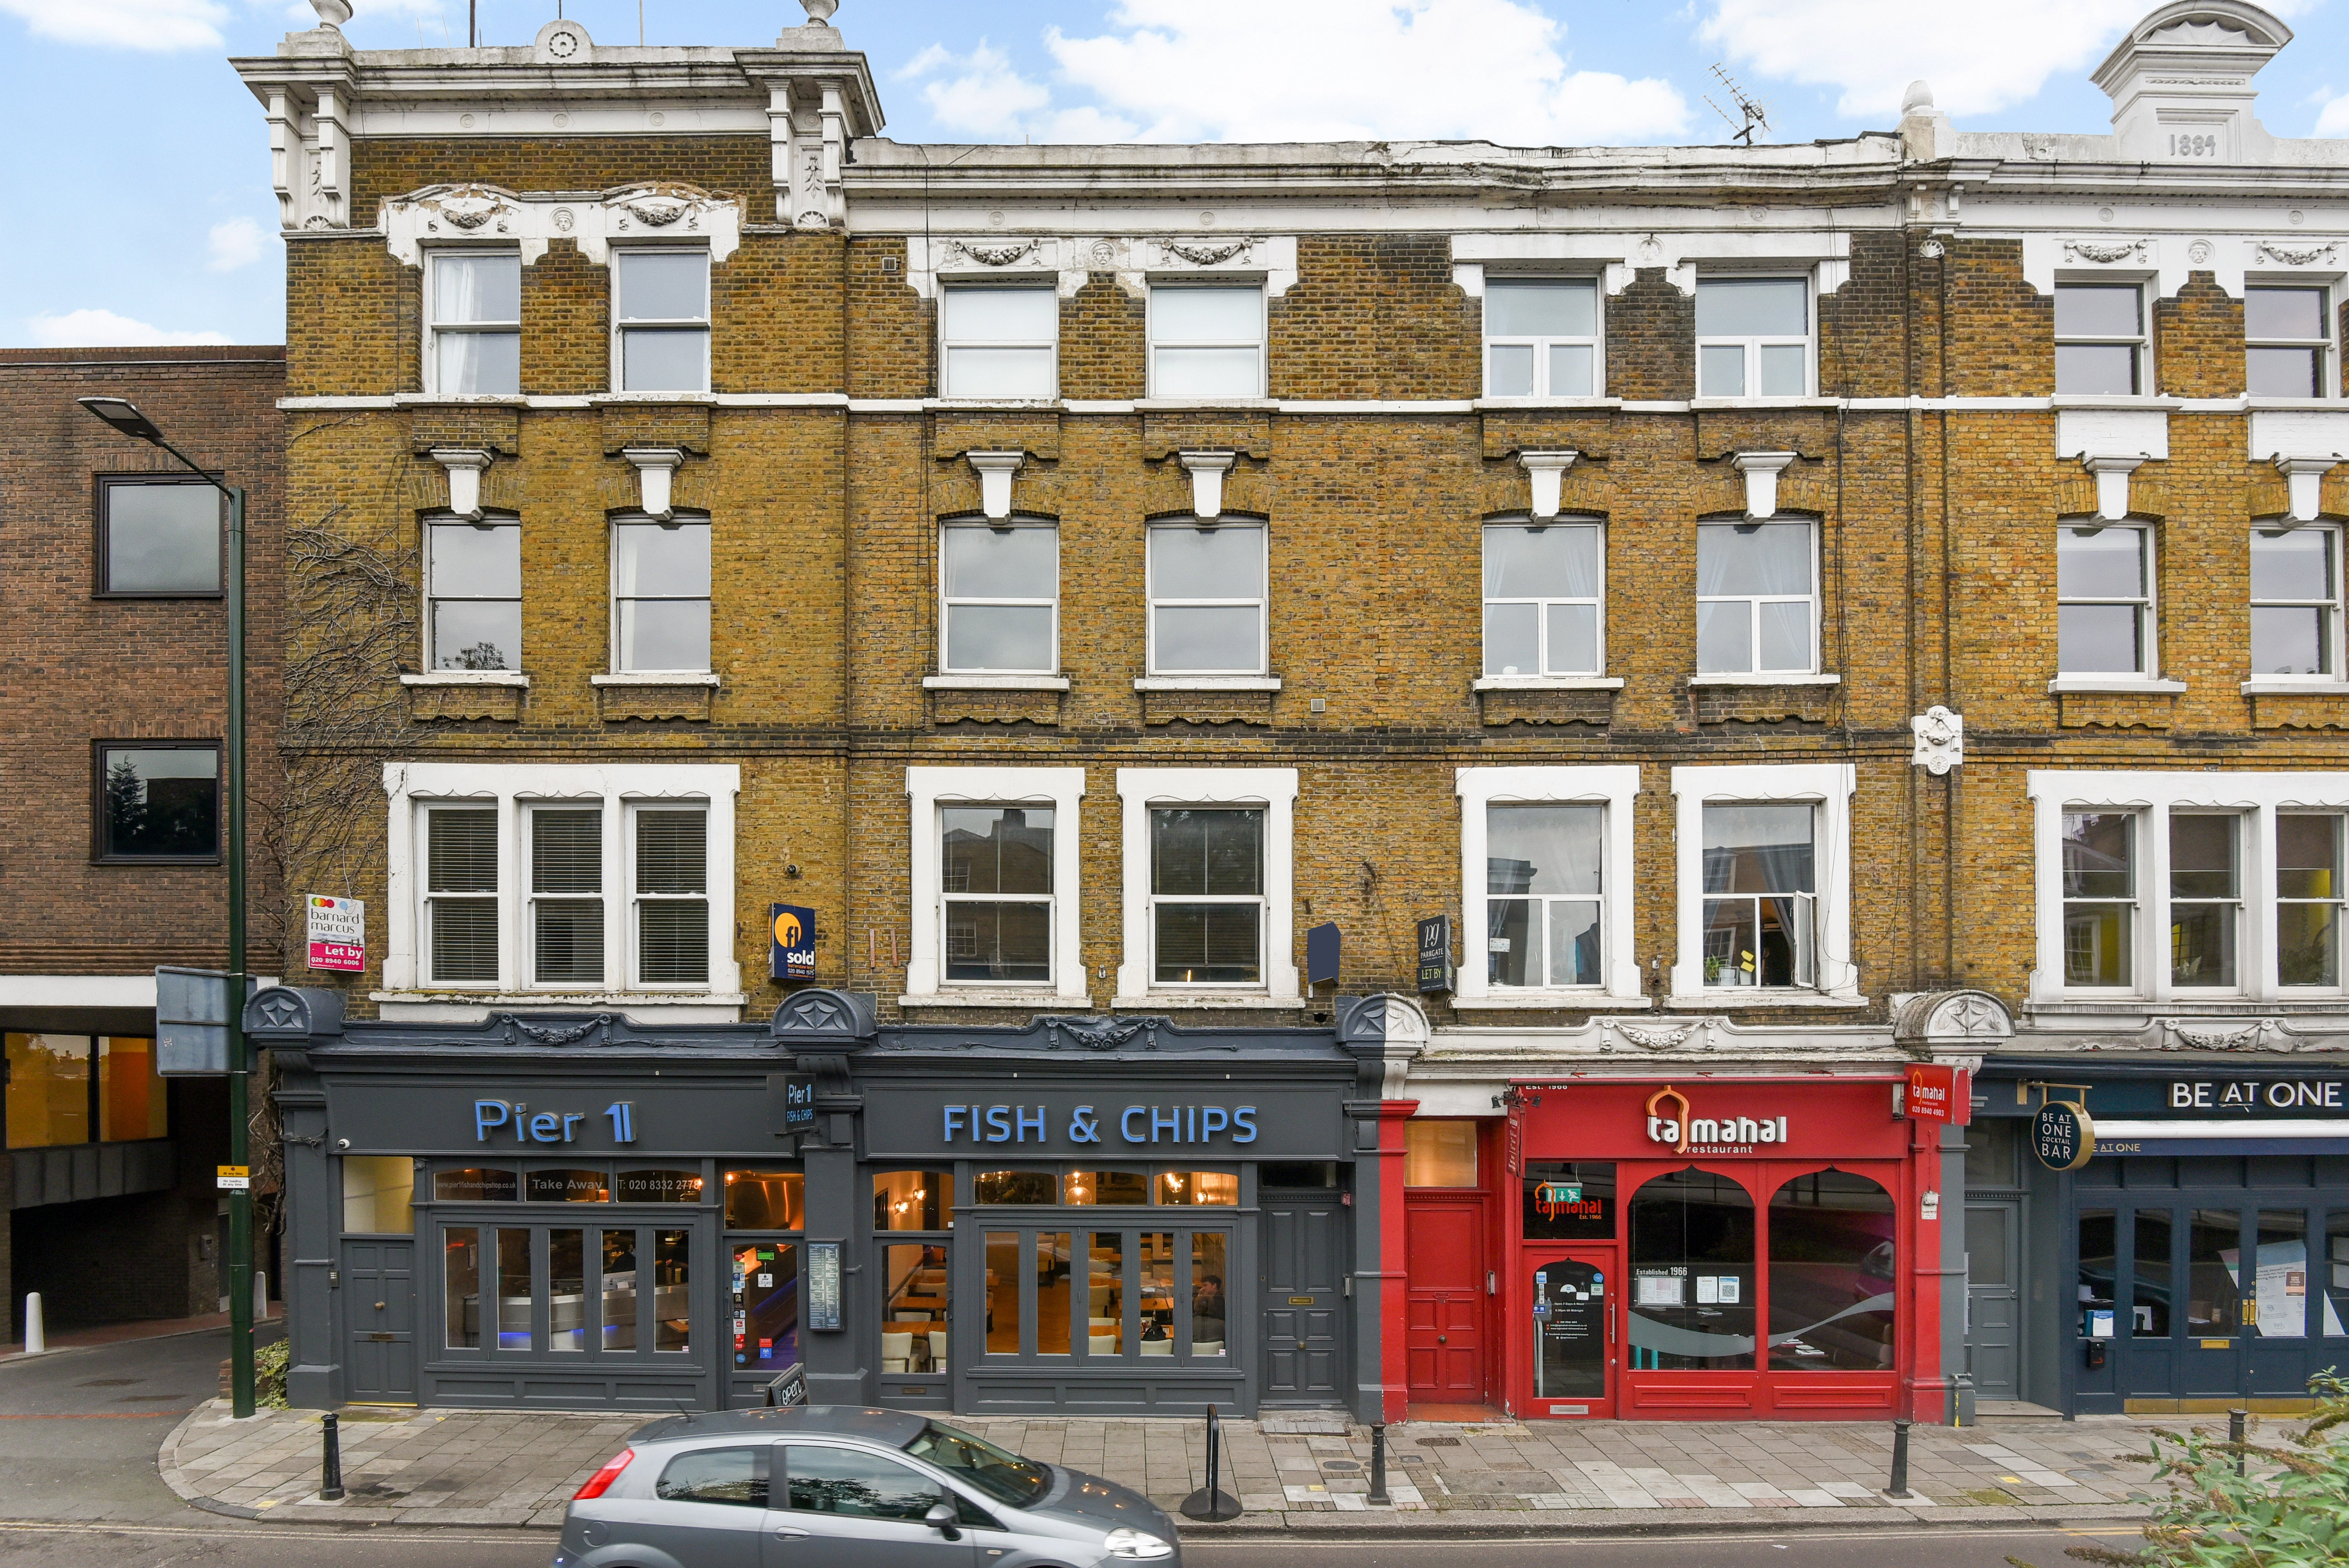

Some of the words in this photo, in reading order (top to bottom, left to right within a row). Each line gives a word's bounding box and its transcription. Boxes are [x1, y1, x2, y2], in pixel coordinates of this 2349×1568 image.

[2169, 134, 2216, 157] 1884
[311, 908, 359, 924] barnard
[311, 922, 355, 934] marcus
[1424, 923, 1439, 948] pg
[325, 946, 344, 956] Let
[348, 947, 362, 959] by
[787, 950, 814, 965] sold
[1420, 948, 1443, 959] PARKGATE
[1422, 969, 1432, 980] LET
[1434, 968, 1442, 979] BY
[789, 1084, 805, 1104] Pier
[806, 1084, 811, 1102] 1
[2172, 1083, 2212, 1107] BE
[2224, 1083, 2260, 1102] AT
[2269, 1082, 2342, 1107] ONE
[787, 1110, 796, 1122] FISH
[797, 1110, 800, 1121] &
[801, 1109, 813, 1121] CHIPS
[1921, 1107, 1932, 1115] 8940
[1933, 1108, 1944, 1117] 4903
[2042, 1112, 2053, 1122] BE
[2058, 1114, 2071, 1123] AT
[475, 1099, 584, 1142] Pier
[603, 1101, 636, 1142] 1
[944, 1105, 1045, 1142] FISH
[1069, 1105, 1101, 1143] &
[1121, 1105, 1257, 1143] CHIPS
[2042, 1123, 2071, 1137] ONE
[2042, 1136, 2071, 1145] COCKTAIL
[1686, 1145, 1752, 1153] restaurant
[2042, 1143, 2071, 1160] BAR
[2116, 1143, 2140, 1152] ONE
[436, 1181, 516, 1189] www.pier1fishandchipshop.co.uk
[533, 1180, 563, 1189] Take
[567, 1180, 602, 1191] Away
[618, 1180, 625, 1189] T:
[629, 1180, 646, 1190] 020
[649, 1180, 673, 1190] 8332
[676, 1180, 699, 1190] 2778
[1670, 1267, 1688, 1276] 1966
[782, 1380, 802, 1406] open
